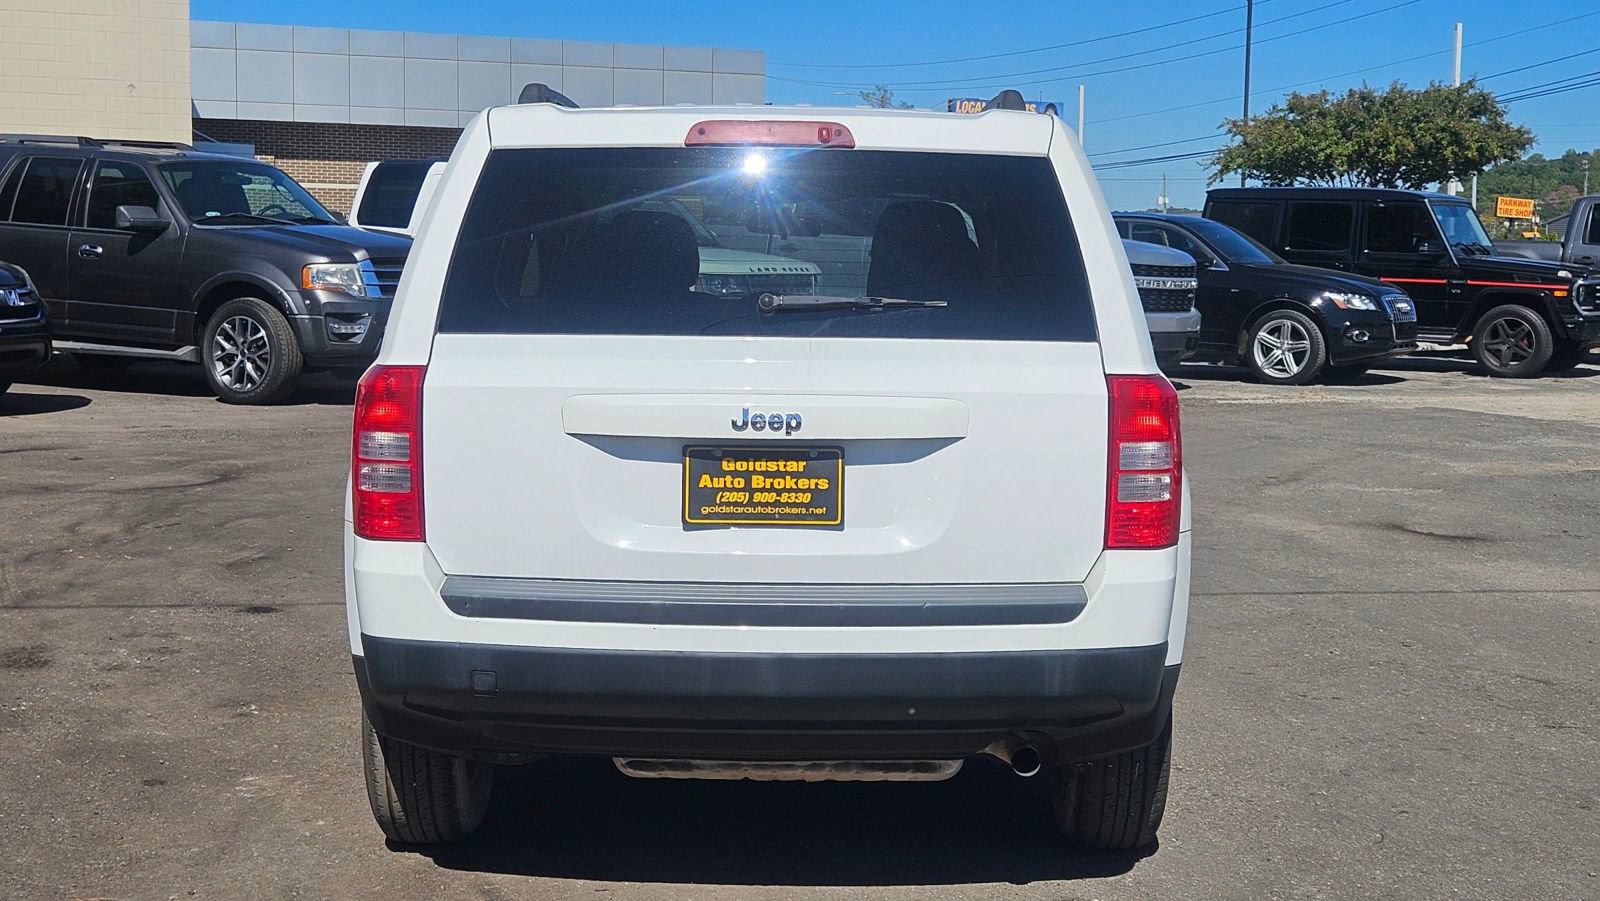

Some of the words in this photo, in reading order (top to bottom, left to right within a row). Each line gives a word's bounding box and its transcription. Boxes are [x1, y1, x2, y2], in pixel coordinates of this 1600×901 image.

[1500, 199, 1532, 207] PARKWAY
[1499, 207, 1513, 215] TIRE
[1514, 208, 1532, 216] SHOP
[731, 407, 802, 436] Jeep
[721, 457, 806, 472] Goldstar
[698, 475, 745, 488] Auto
[751, 475, 830, 490] Brokers
[716, 491, 749, 504] (205)
[752, 492, 812, 504] 900-8330
[700, 505, 827, 515] goldstarautobrokers.net
